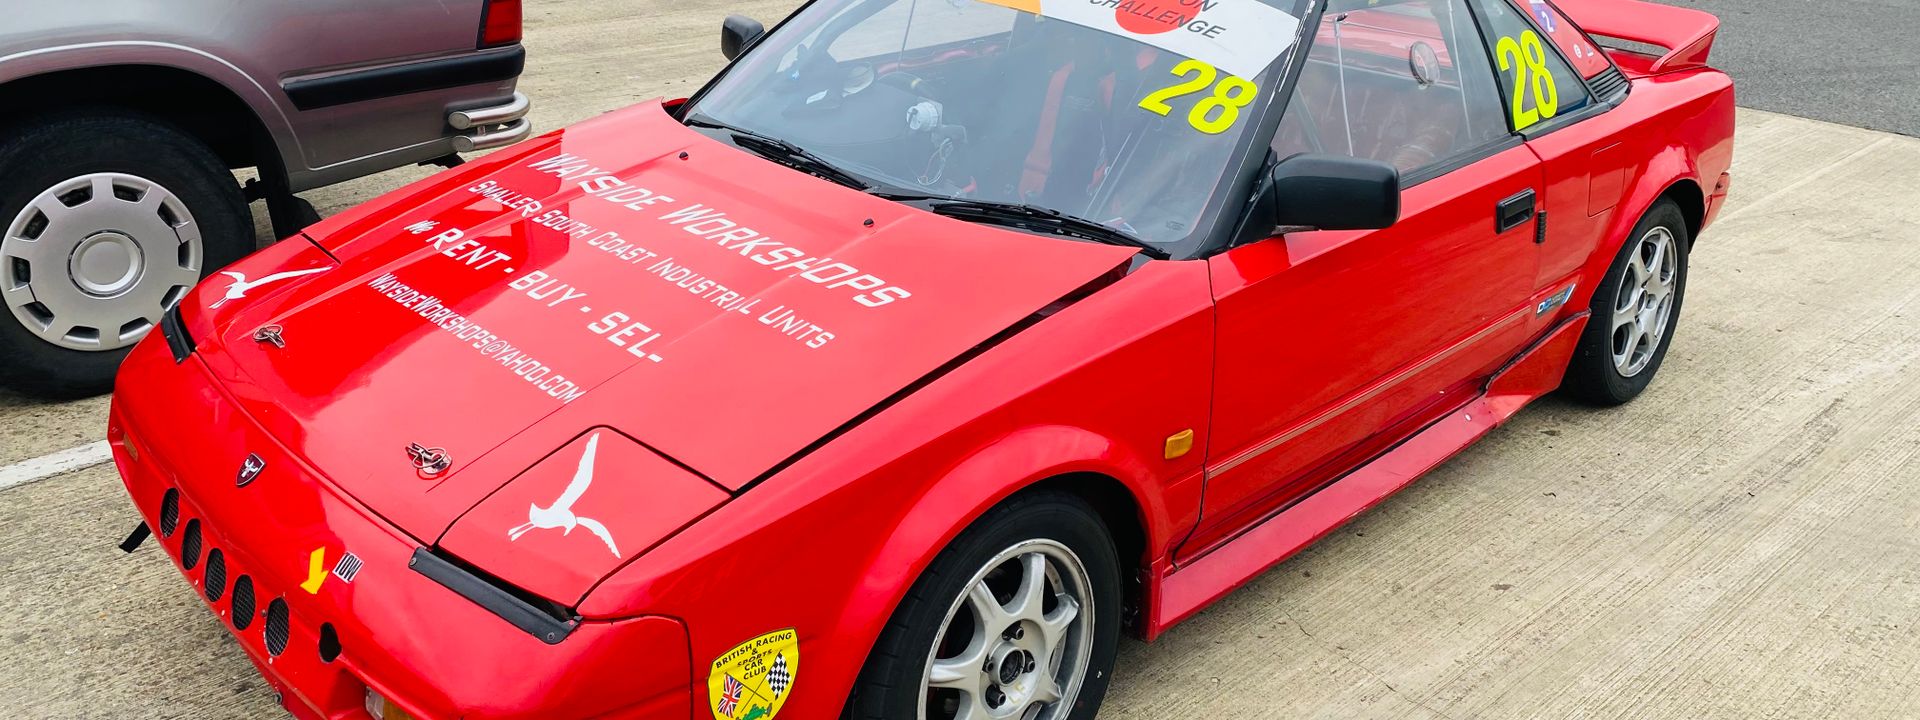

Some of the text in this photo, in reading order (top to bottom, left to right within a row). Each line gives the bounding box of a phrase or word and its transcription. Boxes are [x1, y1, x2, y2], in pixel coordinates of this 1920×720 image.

[1138, 59, 1257, 134] 28
[1496, 30, 1557, 131] 28
[527, 153, 912, 308] WAYSIDE WORKSHOPS
[468, 180, 543, 217] SMALLER
[532, 209, 597, 239] SOUTH
[587, 231, 659, 264] COAST
[758, 305, 835, 349] UNITS
[425, 227, 513, 271] RENT
[507, 269, 588, 307] BUY
[587, 311, 663, 363] SEL
[335, 551, 363, 582] TOW
[716, 632, 792, 668] BRITISH RACING
[737, 649, 773, 666] SPORTS
[744, 666, 767, 680] CLUB
[745, 659, 763, 671] CAR
